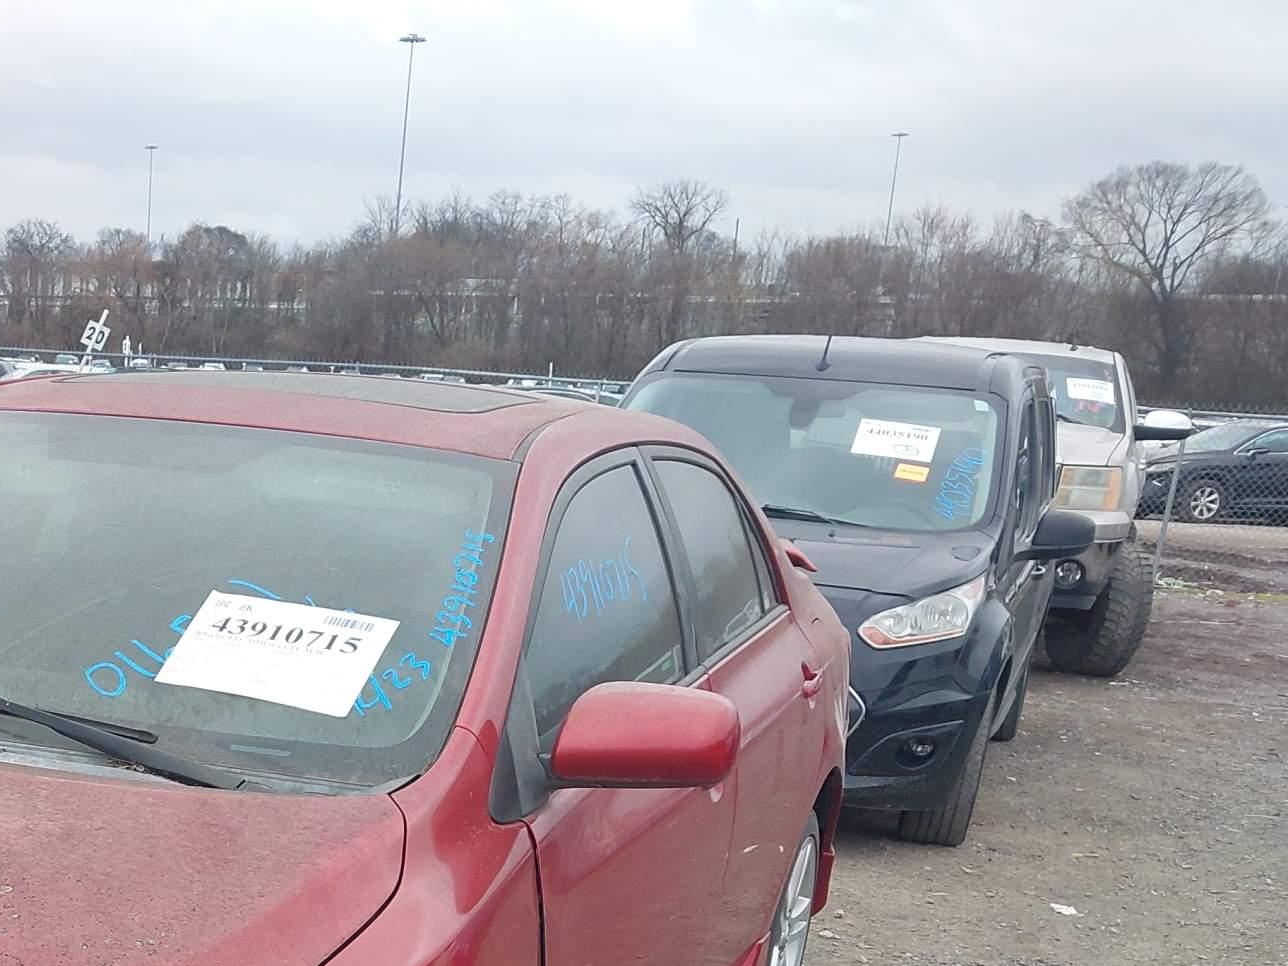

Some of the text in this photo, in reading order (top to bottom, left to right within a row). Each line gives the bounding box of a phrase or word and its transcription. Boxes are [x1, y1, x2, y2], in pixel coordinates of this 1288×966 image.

[85, 326, 105, 344] 20
[428, 527, 495, 647] 43910715
[559, 536, 648, 622] 43910715
[212, 616, 363, 654] 43910715
